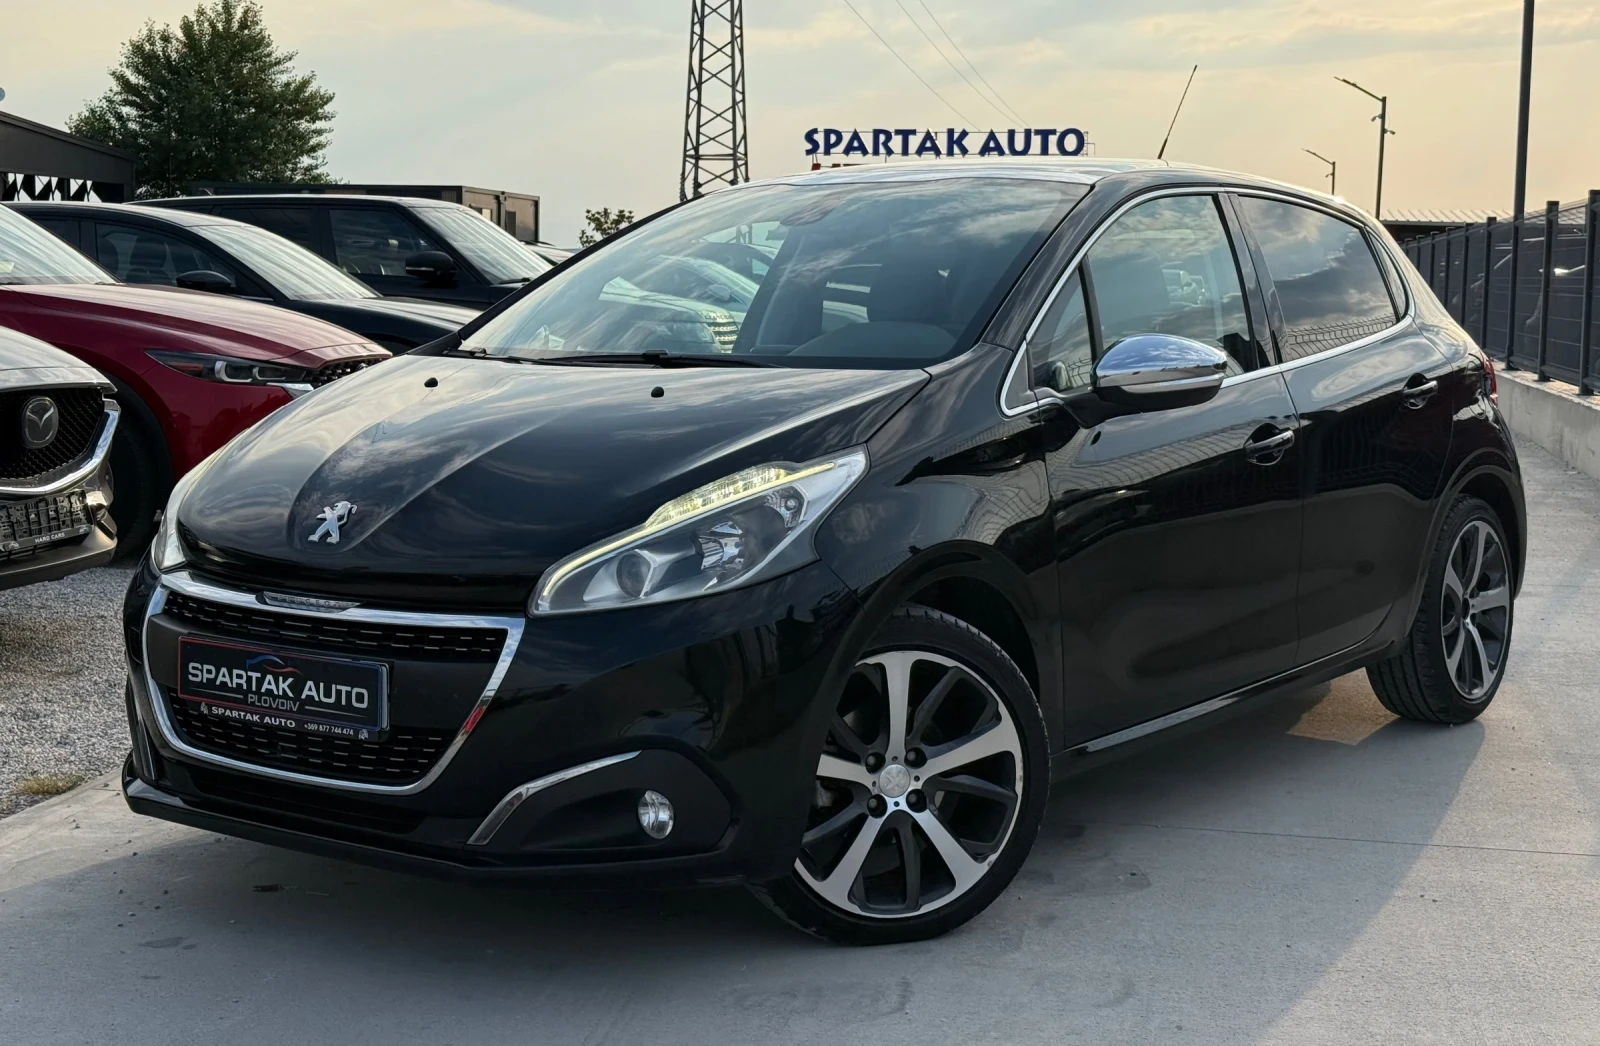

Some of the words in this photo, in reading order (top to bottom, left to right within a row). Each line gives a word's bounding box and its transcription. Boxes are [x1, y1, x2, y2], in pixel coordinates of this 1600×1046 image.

[804, 127, 969, 157] SPARTAK
[978, 127, 1085, 157] AUTO
[34, 535, 50, 544] HARD
[51, 532, 65, 540] CARS
[188, 662, 294, 698] SPARTAK
[301, 680, 369, 709] AUTO
[247, 693, 300, 712] PLOVDIV
[211, 706, 260, 722] SPARTAK
[263, 716, 296, 728] AUTO
[319, 724, 330, 732] 877
[331, 726, 342, 734] 744
[342, 728, 354, 736] 474
